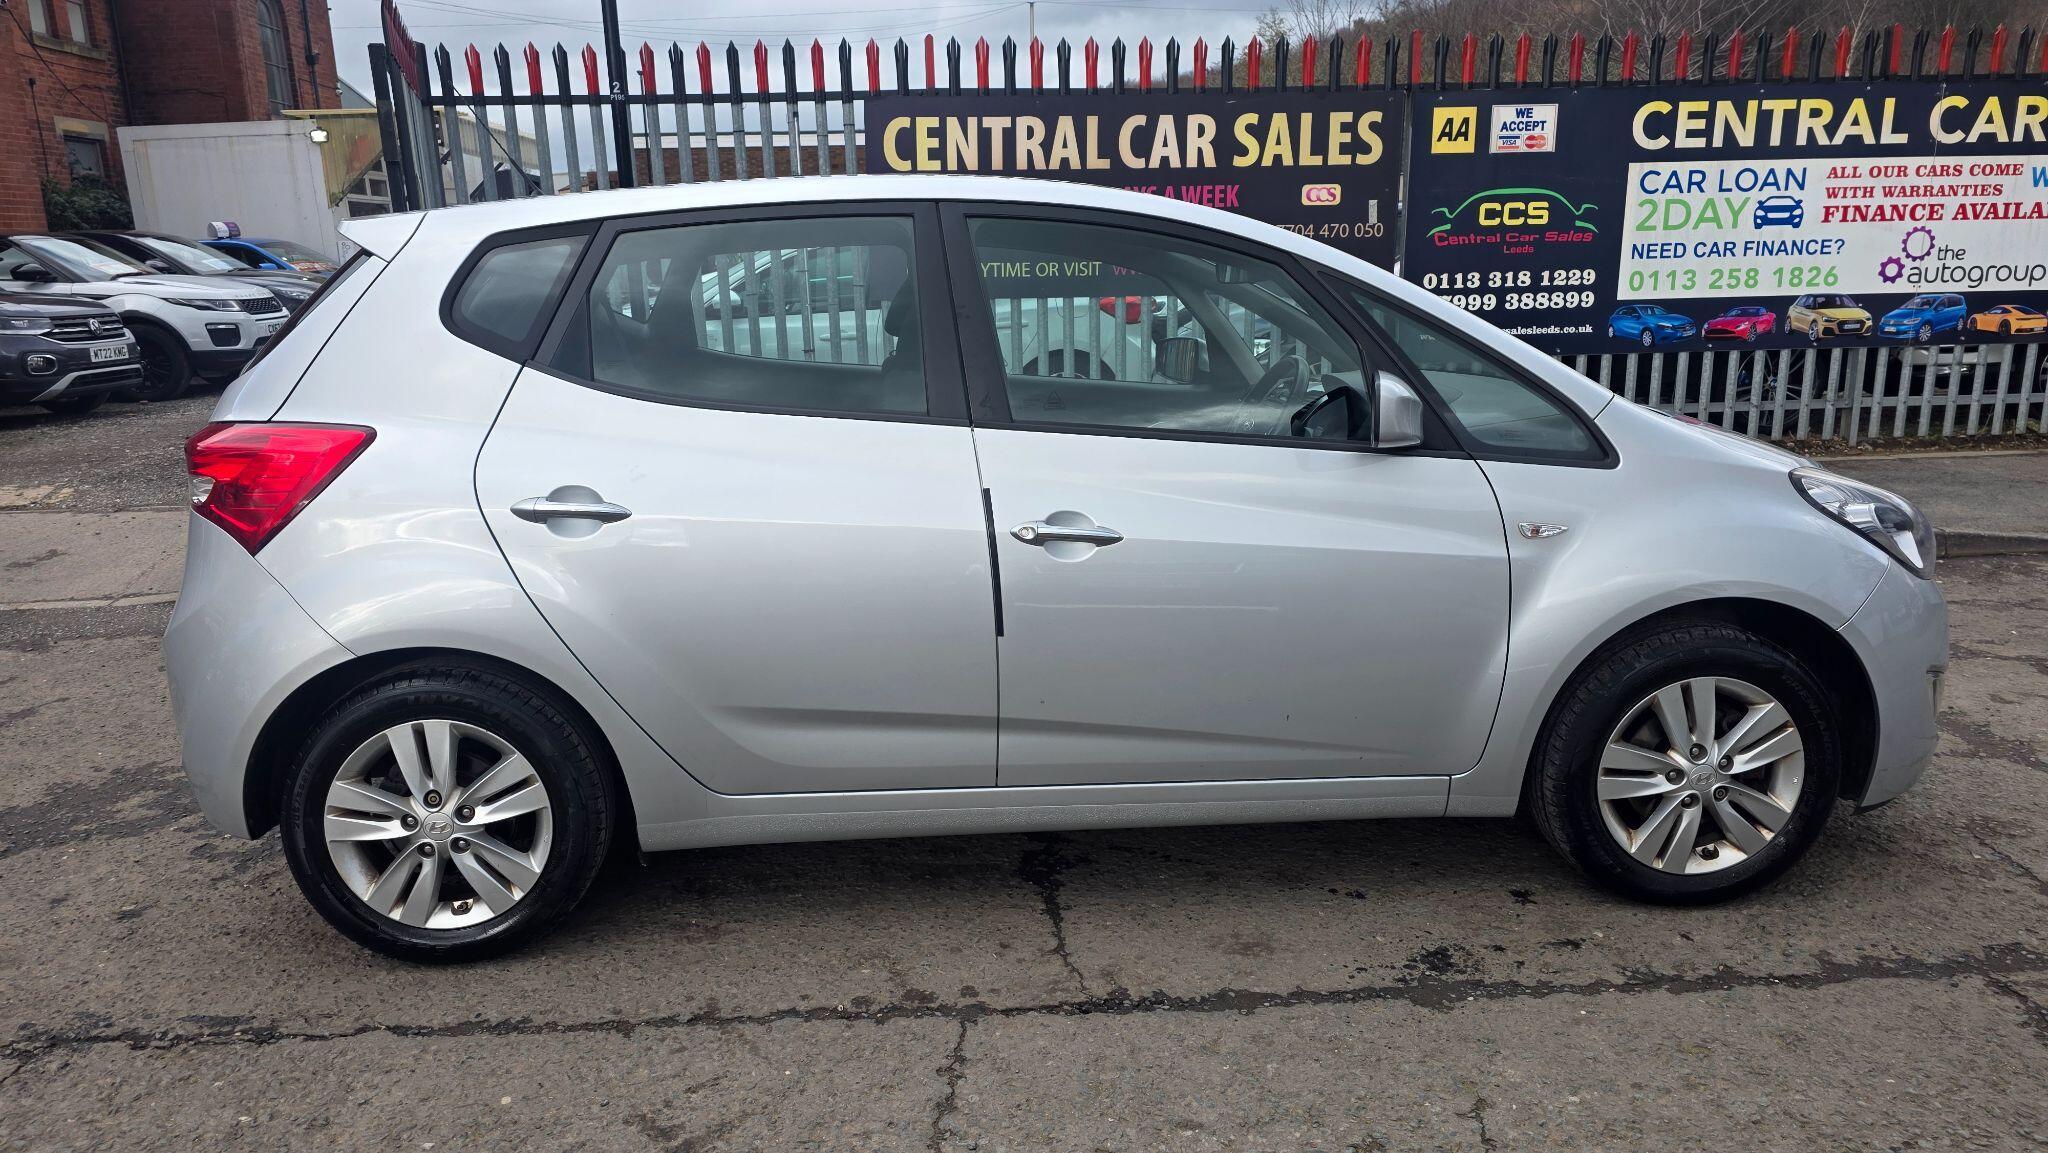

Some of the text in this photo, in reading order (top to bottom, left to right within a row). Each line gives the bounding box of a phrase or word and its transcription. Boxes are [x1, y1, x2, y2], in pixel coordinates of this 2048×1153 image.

[612, 81, 621, 93] 2
[1515, 108, 1533, 118] WE
[1632, 95, 2048, 150] CENTRAL CAR
[1436, 117, 1470, 142] AA
[1500, 120, 1547, 132] ACCEPT
[883, 111, 1384, 171] CENTRAL CAR SALES
[1639, 167, 1807, 195] CAR LOAN
[1826, 163, 2024, 179] ALL OUR CARS COME
[1181, 185, 1240, 207] WEEK
[1825, 183, 2004, 199] WITH WARRANTIES
[1479, 202, 1549, 226] CCS
[1635, 197, 1751, 232] 2DAY
[1821, 203, 1945, 223] FINANCE
[1319, 223, 1349, 238] 470
[1354, 222, 1384, 237] 050
[1434, 230, 1594, 247] Central Car Sales
[1503, 245, 1534, 253] Leeds
[1631, 238, 1845, 260] NEED CAR FINANCE?
[1937, 244, 1966, 260] the
[1035, 262, 1059, 277] OR
[1064, 261, 1102, 276] VISIT
[1422, 268, 1596, 290] 0113 318 1229
[1629, 265, 1839, 292] 0113 258 1826
[1907, 263, 2046, 288] autogroup
[1504, 291, 1595, 310] 388899
